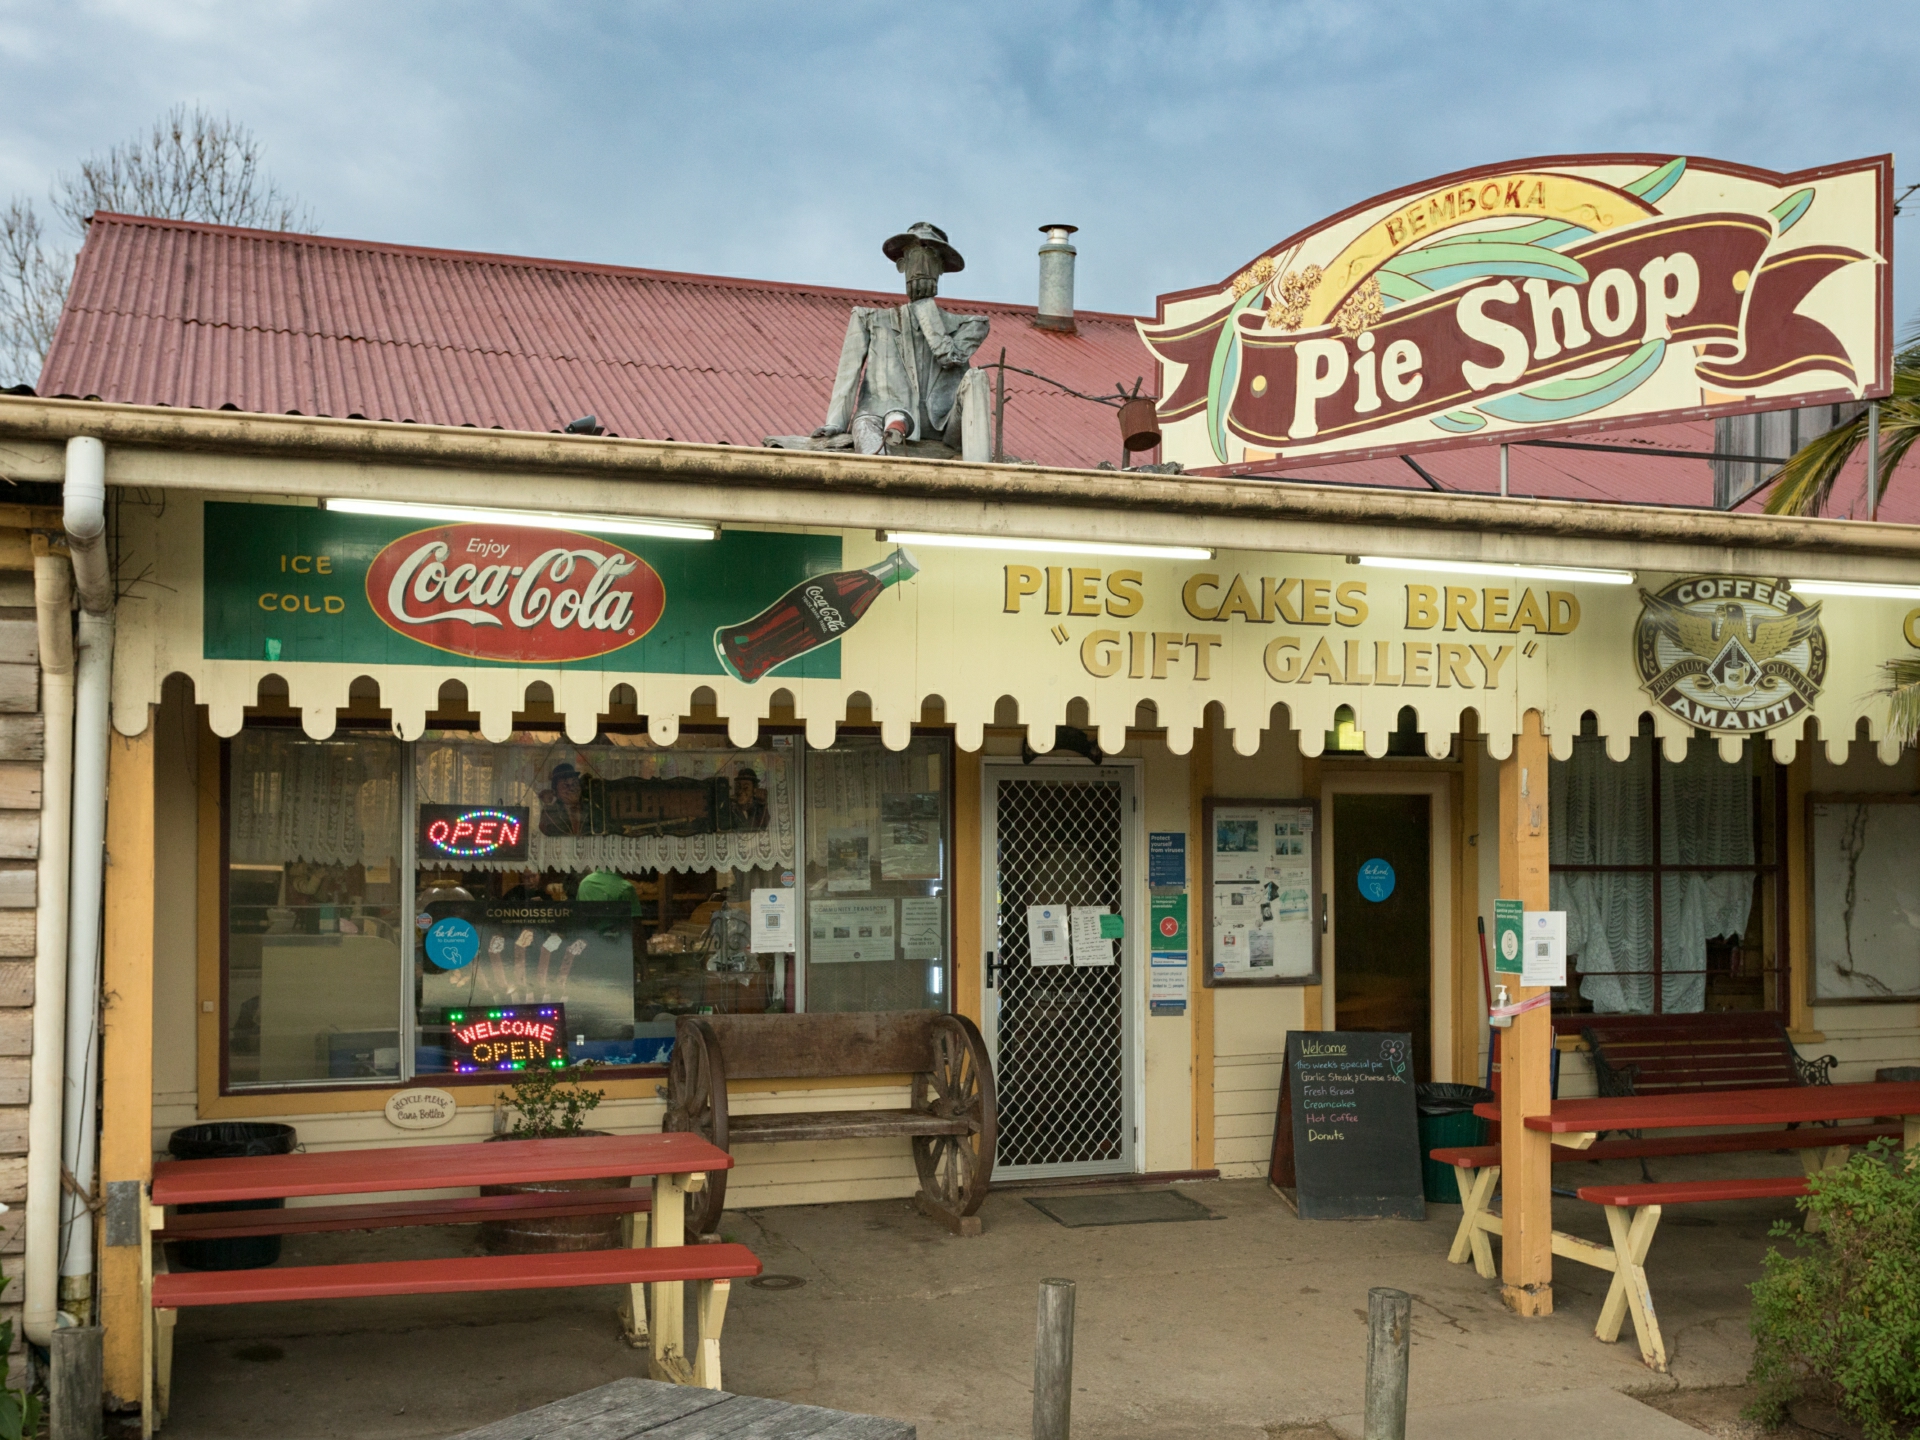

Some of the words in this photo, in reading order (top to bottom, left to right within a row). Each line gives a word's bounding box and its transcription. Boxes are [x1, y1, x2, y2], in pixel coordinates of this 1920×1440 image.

[1385, 180, 1546, 247] BEMBOKA
[1288, 331, 1423, 439] Pie
[1456, 251, 1700, 391] Shop
[466, 537, 510, 558] Enjoy
[281, 554, 333, 575] ICE
[387, 541, 638, 633] Coca-Cola
[1677, 579, 1791, 613] COFFEE
[258, 592, 345, 614] COLD
[805, 585, 847, 632] Coca-Cola
[1003, 564, 1145, 619] PIES
[1182, 573, 1369, 627] CAKES
[1404, 584, 1581, 635] BREAD
[1654, 663, 1704, 693] PREMIUM
[1766, 664, 1814, 697] QUALITY
[1669, 697, 1795, 729] AMANTI
[429, 820, 521, 846] OPEN
[486, 908, 570, 918] CONNOISSEUR
[433, 926, 445, 938] be
[446, 926, 470, 939] kind
[457, 1020, 555, 1044] WELCOME
[473, 1040, 545, 1062] OPEN
[1301, 1040, 1347, 1055] Welcome
[1295, 1060, 1311, 1070] This
[1340, 1060, 1370, 1071] special
[1371, 1061, 1383, 1073] pie
[1301, 1071, 1325, 1082] Garlic
[1360, 1073, 1385, 1082] Cheese
[1304, 1085, 1327, 1096] Fresh
[1330, 1086, 1355, 1095] Bread
[424, 1095, 448, 1109] PLEASE
[1304, 1100, 1357, 1109] Creamcakes
[1306, 1114, 1325, 1123] Hot
[1330, 1113, 1359, 1122] Coffee
[1309, 1129, 1345, 1141] Donuts
